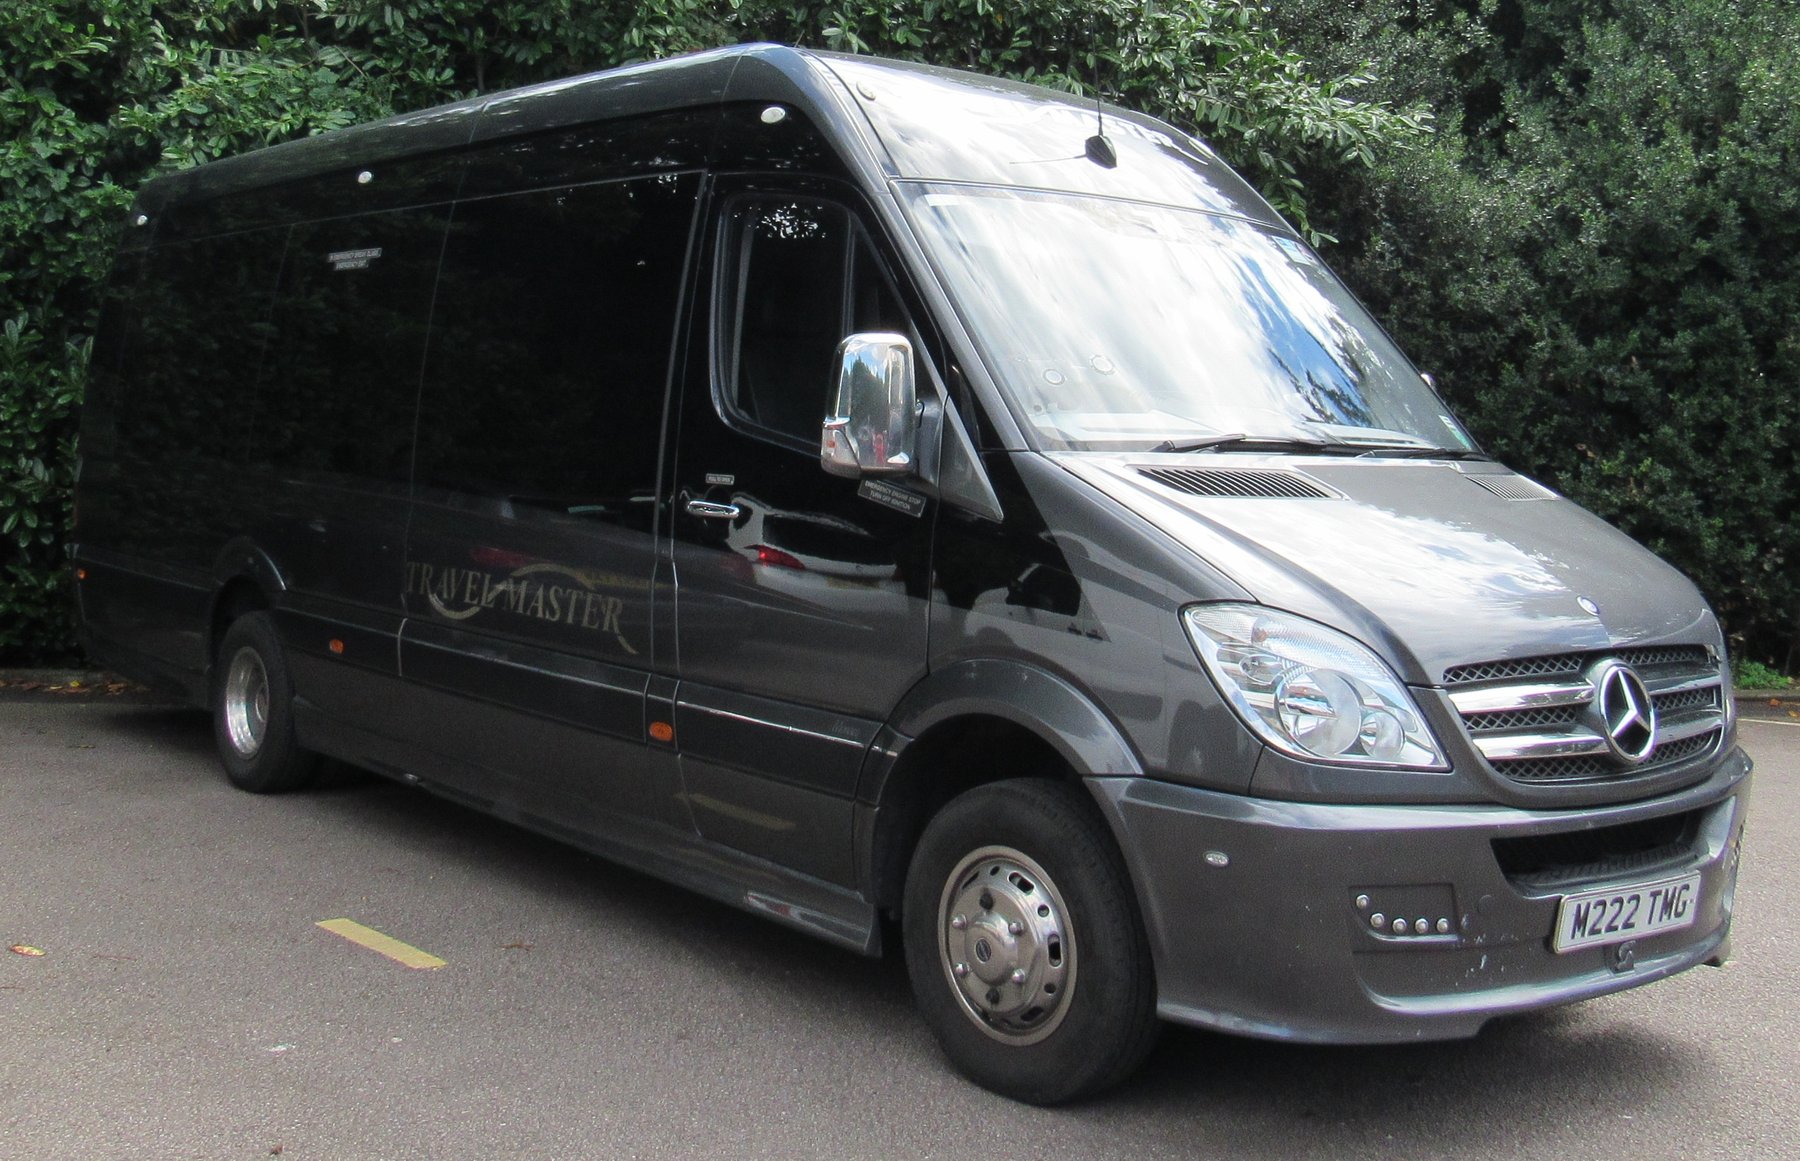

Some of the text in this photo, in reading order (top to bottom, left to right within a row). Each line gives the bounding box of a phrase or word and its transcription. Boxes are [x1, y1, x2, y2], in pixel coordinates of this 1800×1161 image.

[865, 480, 891, 495] EMERGENCY
[908, 496, 921, 505] STOP
[406, 561, 638, 654] TRAVEL MASTER
[1571, 883, 1690, 940] M222 TMG
